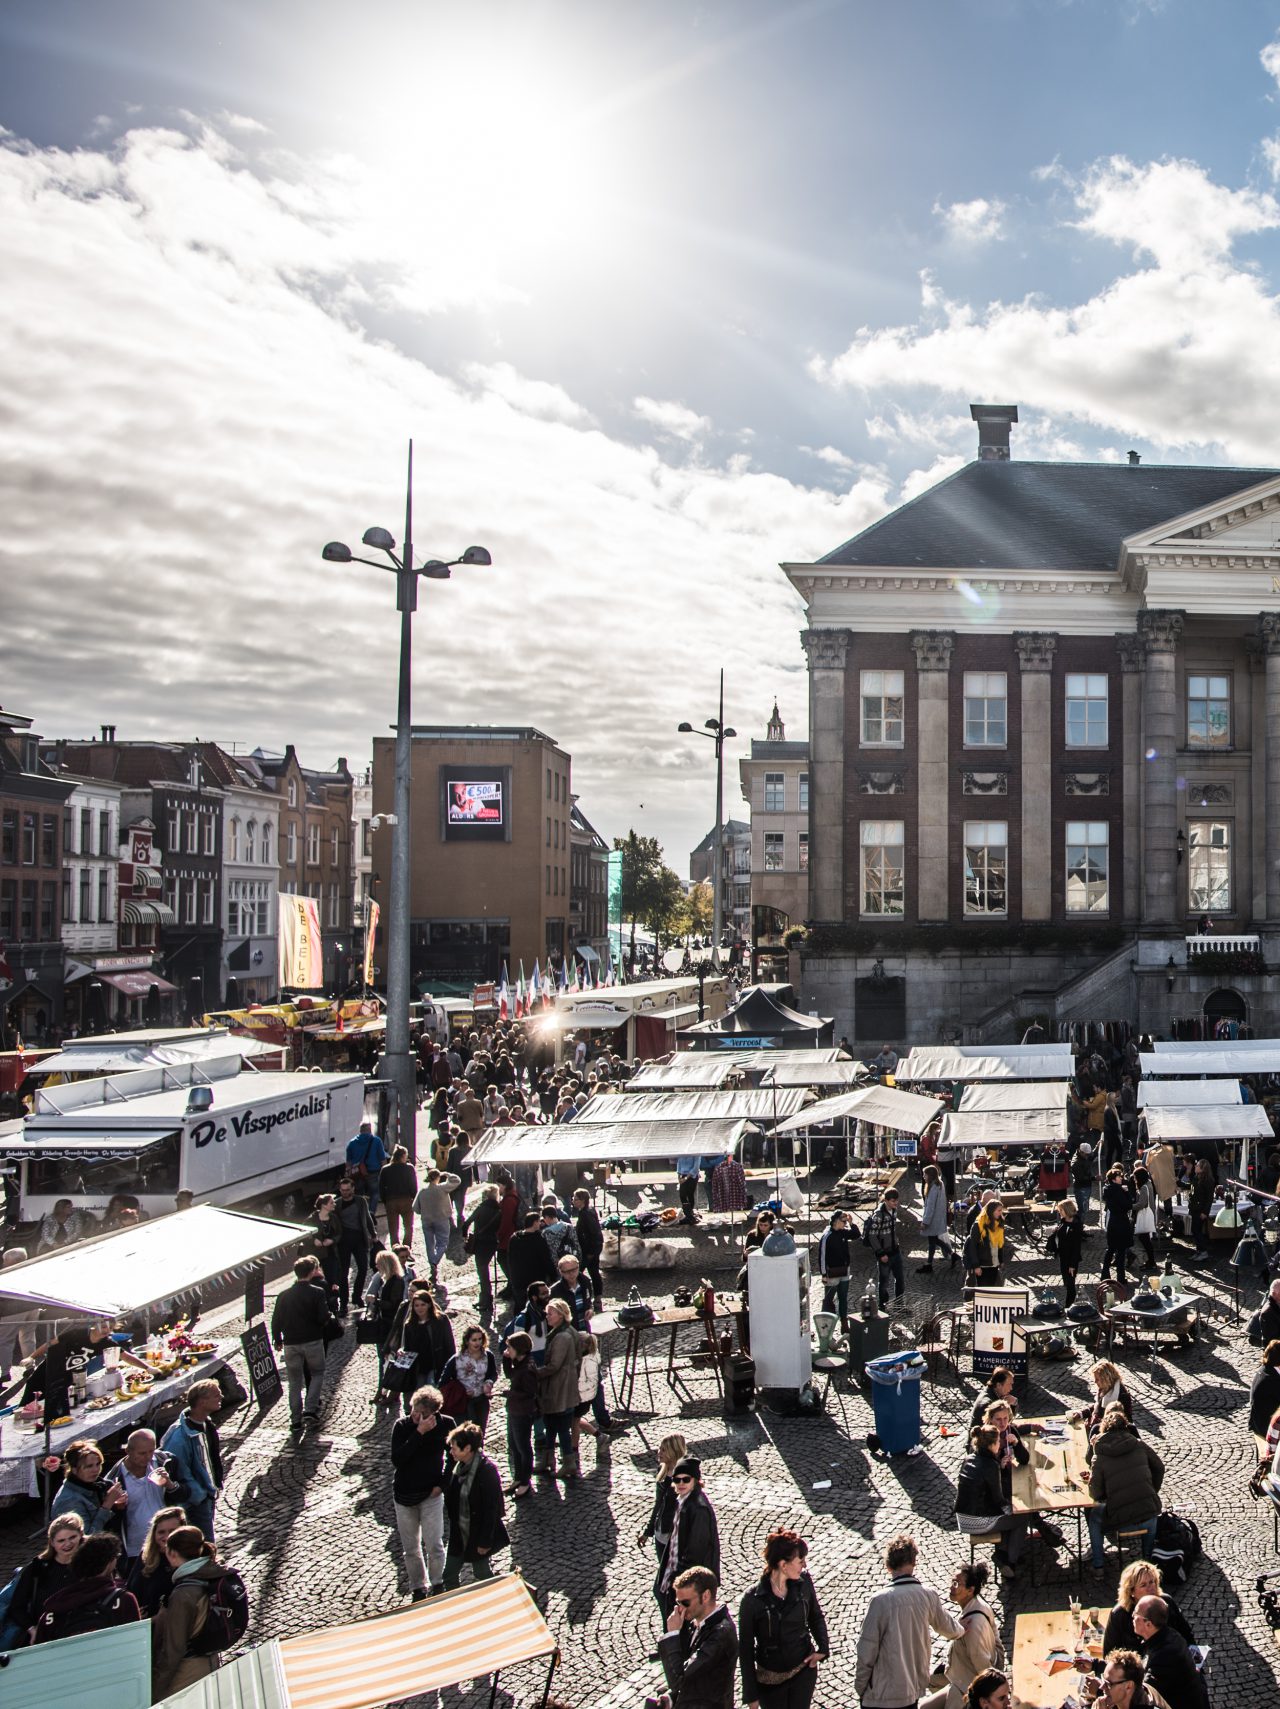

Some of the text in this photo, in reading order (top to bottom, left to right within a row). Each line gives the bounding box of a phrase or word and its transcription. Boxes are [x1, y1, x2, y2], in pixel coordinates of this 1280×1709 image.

[730, 1038, 762, 1047] Verroest
[190, 1092, 332, 1149] De Visspecialist
[975, 1305, 1025, 1325] HUNTER
[253, 1356, 274, 1380] GOUD
[982, 1357, 1016, 1365] AMERICAN
[45, 1612, 54, 1625] S
